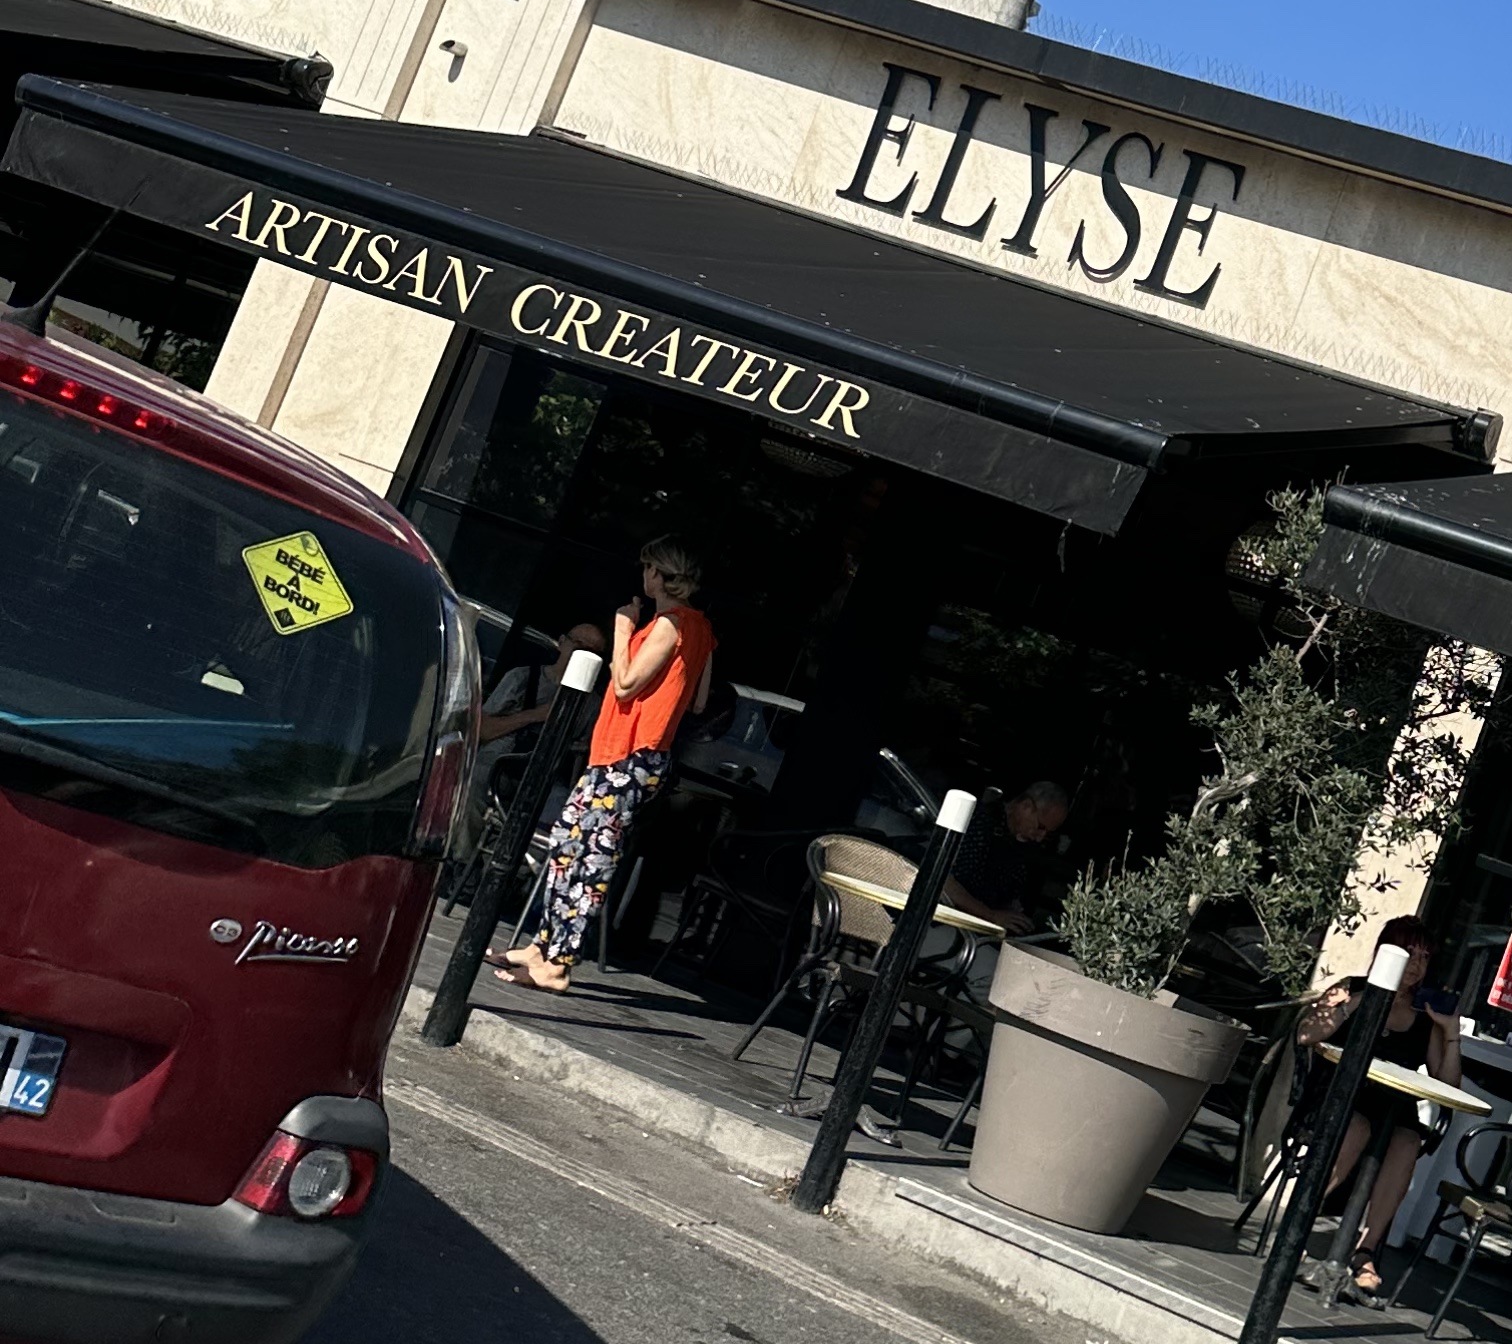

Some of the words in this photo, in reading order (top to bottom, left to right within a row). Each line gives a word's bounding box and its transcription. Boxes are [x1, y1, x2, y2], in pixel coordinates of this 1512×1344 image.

[836, 62, 1246, 305] ELYSE
[205, 190, 493, 317] ARTISAN
[511, 283, 872, 440] CREATEUR
[275, 548, 326, 585] BÉBÉ
[264, 574, 320, 616] BORD!
[13, 1074, 51, 1108] 42
